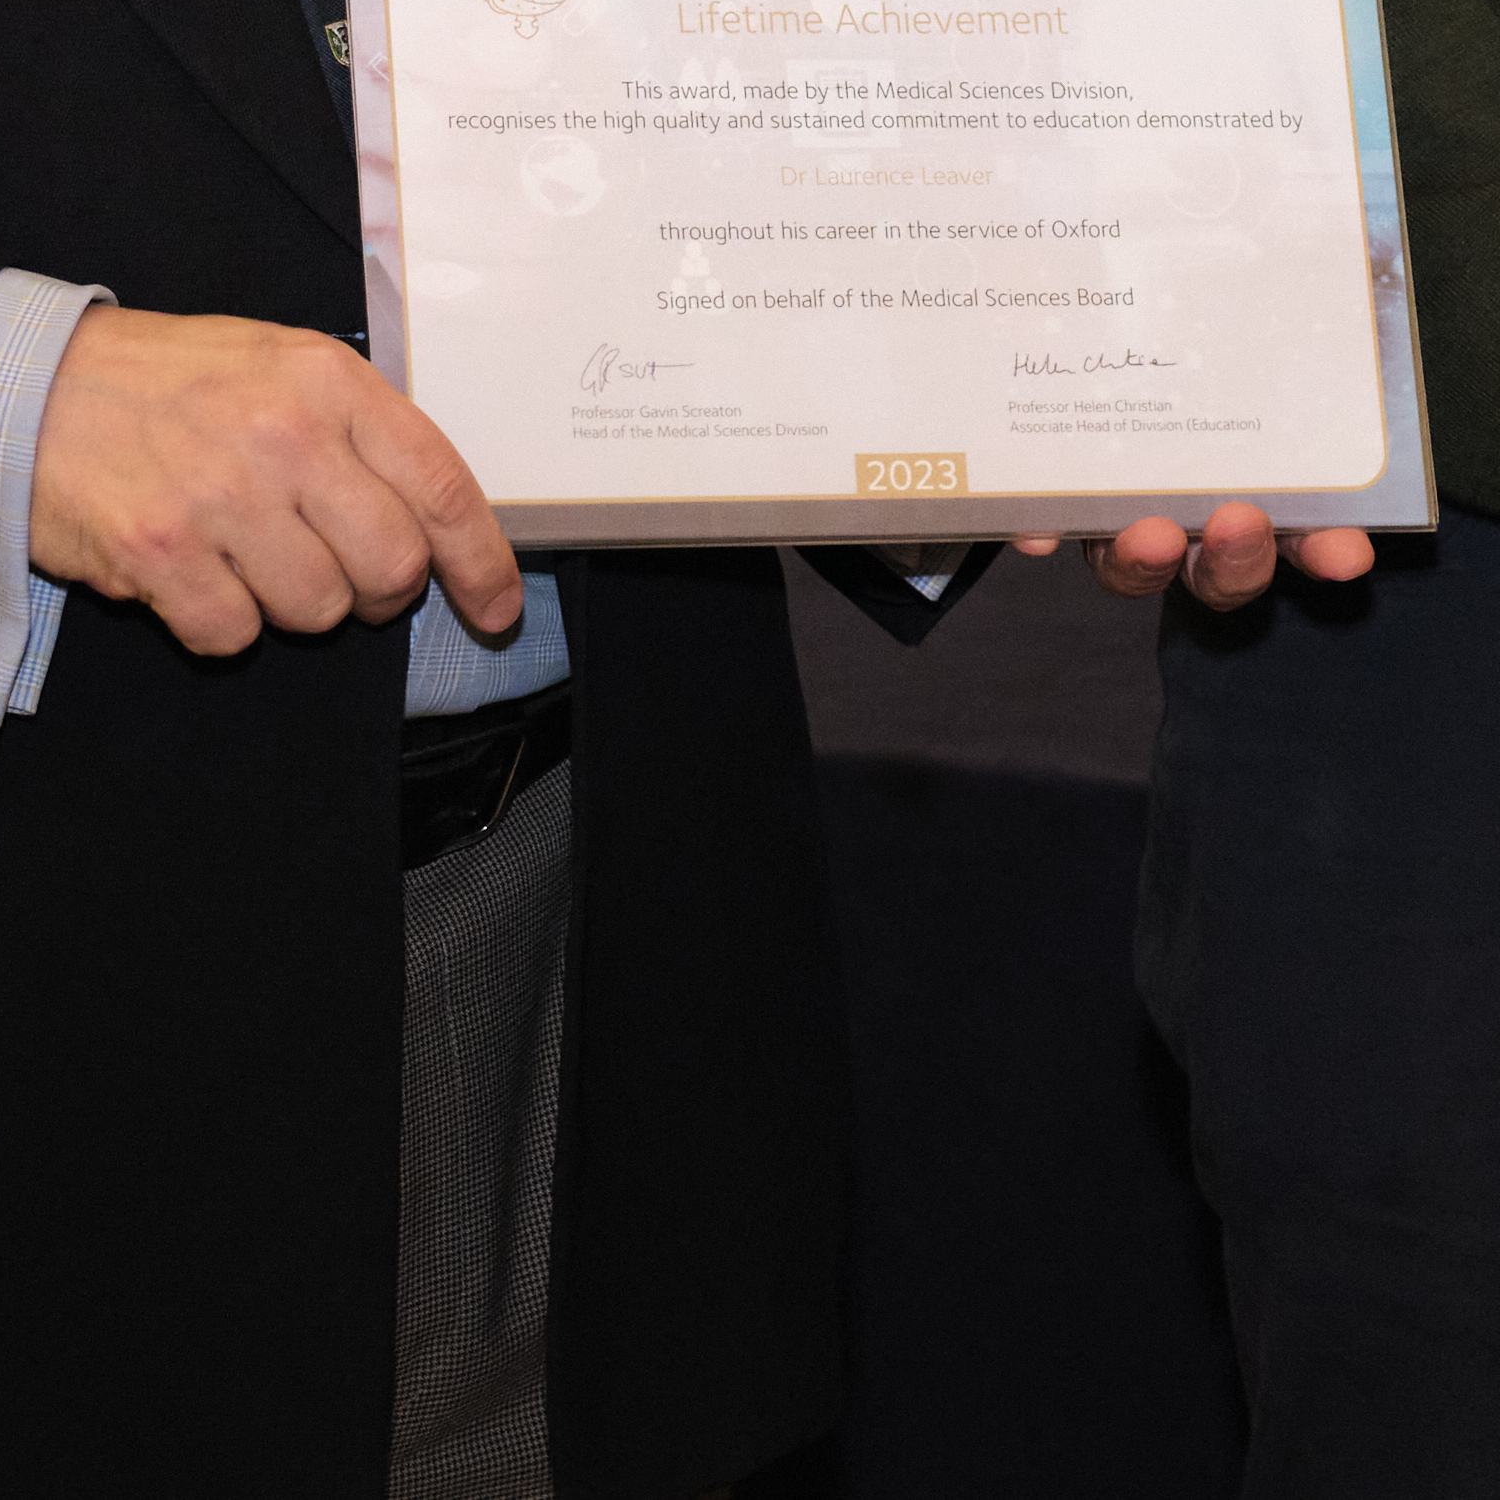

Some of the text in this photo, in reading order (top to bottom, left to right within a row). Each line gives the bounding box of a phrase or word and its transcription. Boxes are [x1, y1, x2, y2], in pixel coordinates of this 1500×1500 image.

[677, 1, 1069, 35] Lifetime Achievement
[622, 80, 1134, 104] This award, made by the Medical Sciences Division,
[448, 110, 1302, 134] recognises the high quality and sustained commitment to education demonstrated by
[781, 165, 994, 186] Dr Laurence Leaver
[660, 220, 1121, 245] throughout his career in the service of Oxford
[657, 287, 1134, 314] Signed on behalf of the Medical Sciences Board
[572, 405, 742, 419] Professor Gavin Screaton
[1009, 400, 1172, 413] Professor Helen Christian
[573, 423, 828, 439] Head of the Medical Sciences Division
[1011, 417, 1261, 433] Associate Head of Division (Education)
[866, 461, 958, 492] 2023
